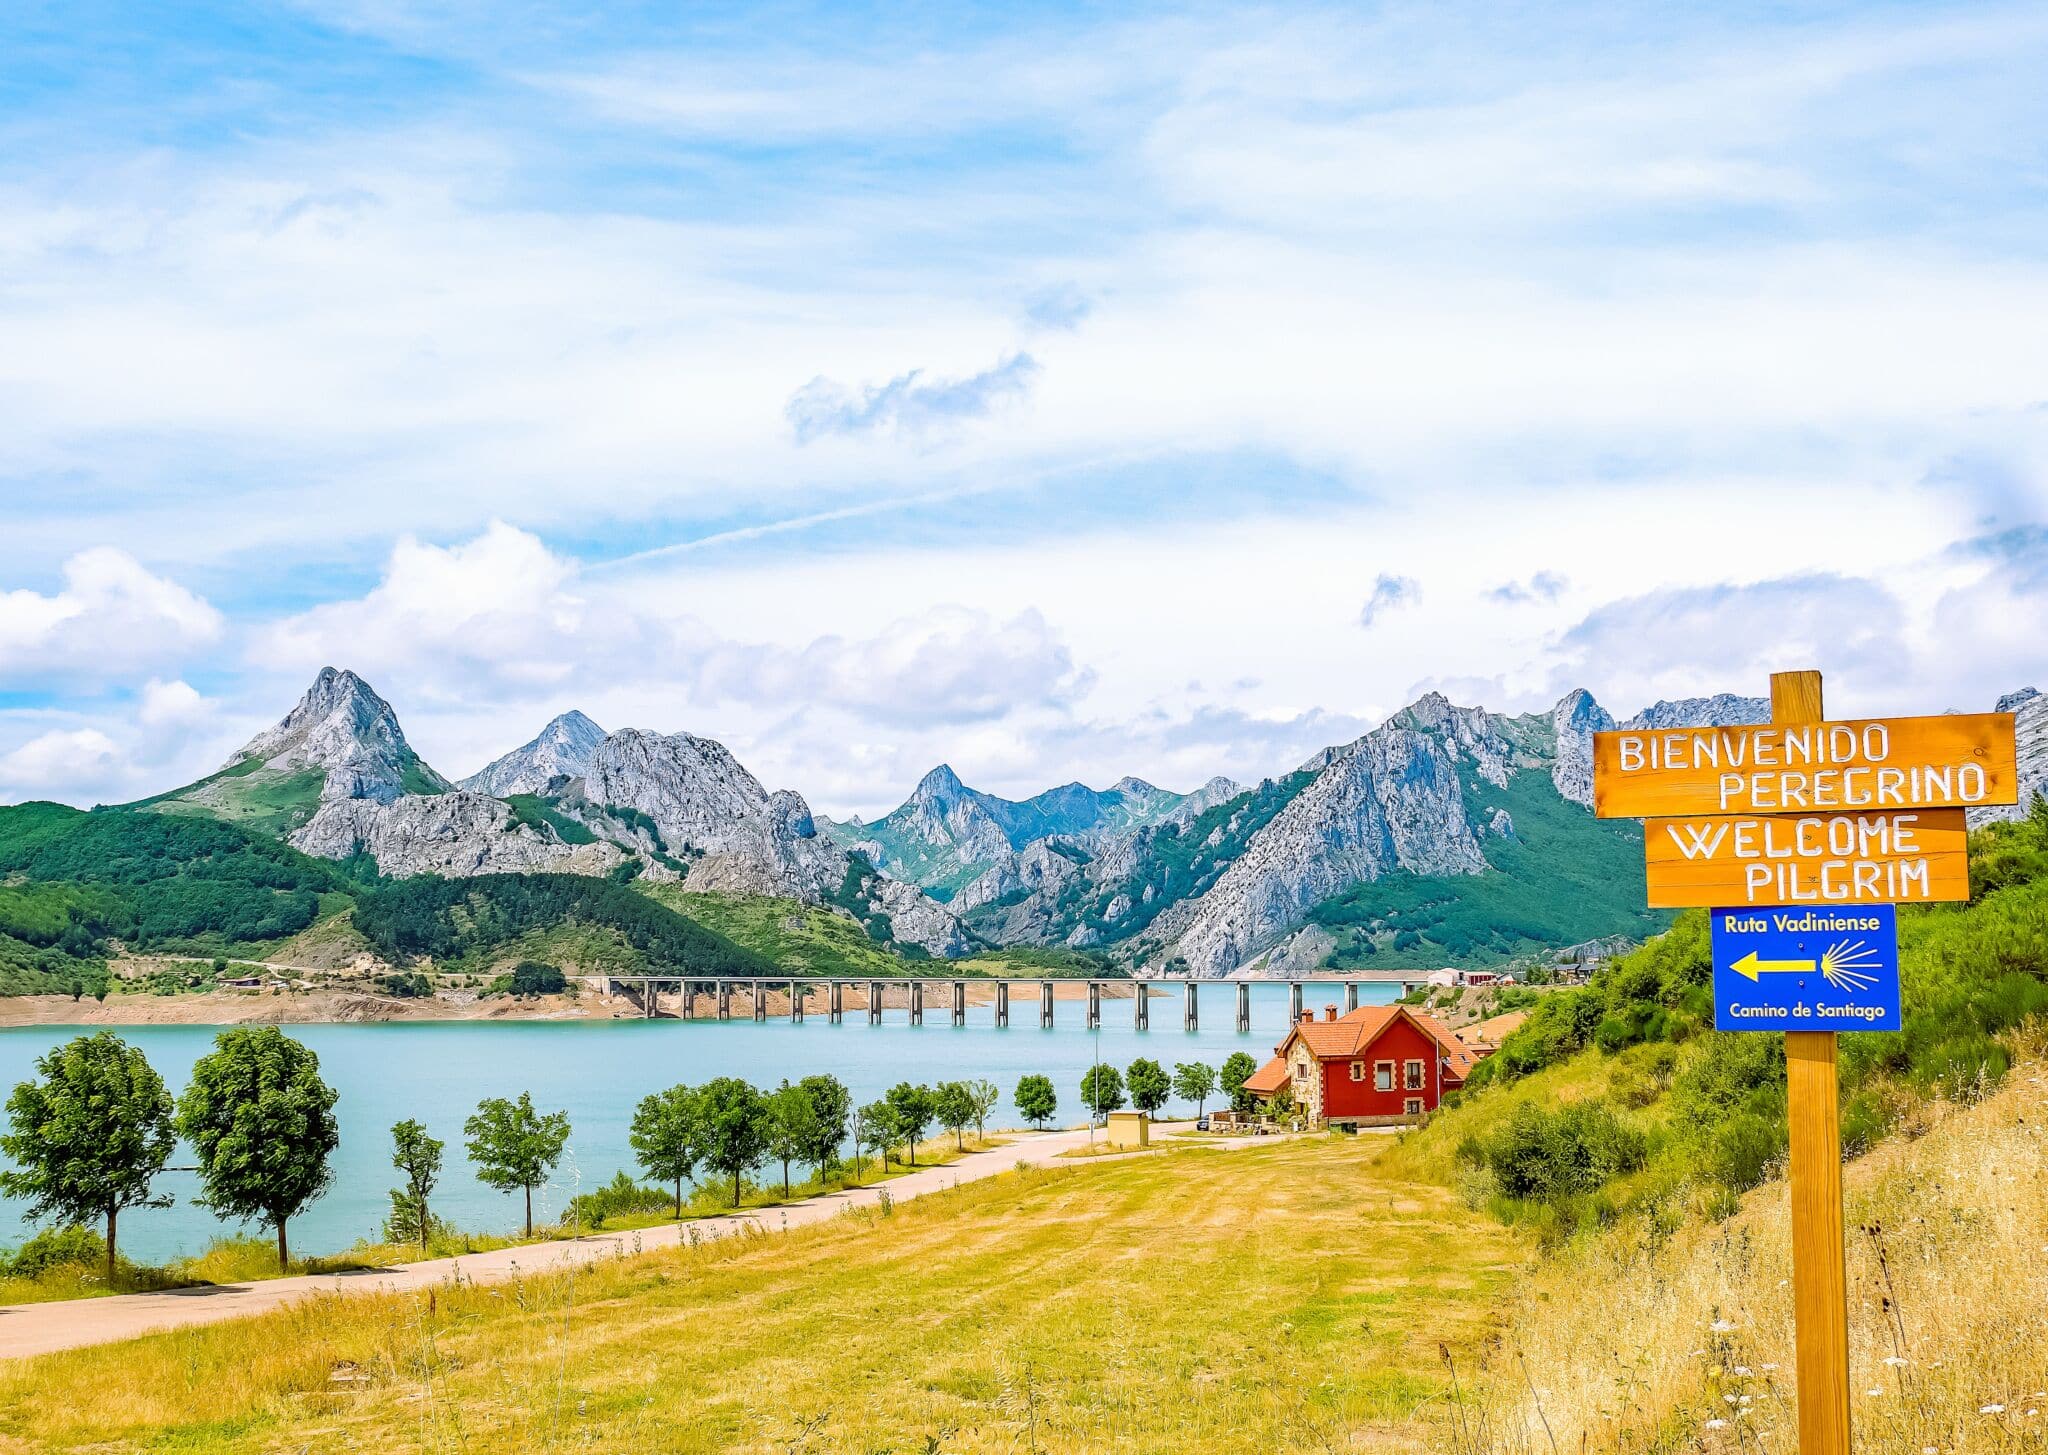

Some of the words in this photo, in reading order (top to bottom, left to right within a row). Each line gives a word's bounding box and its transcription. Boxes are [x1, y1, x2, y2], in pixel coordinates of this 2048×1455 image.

[1619, 723, 1889, 772] BIENVENIDO
[1719, 762, 1986, 810] PEREGRINO
[1667, 814, 1921, 860] WELCOME
[1745, 858, 1930, 901] PILGRIM
[1724, 915, 1768, 933] Ruta
[1773, 913, 1880, 932] Vadiniense
[1729, 1002, 1788, 1018] Camino
[1792, 1001, 1812, 1018] de
[1816, 1001, 1886, 1021] Santiago
